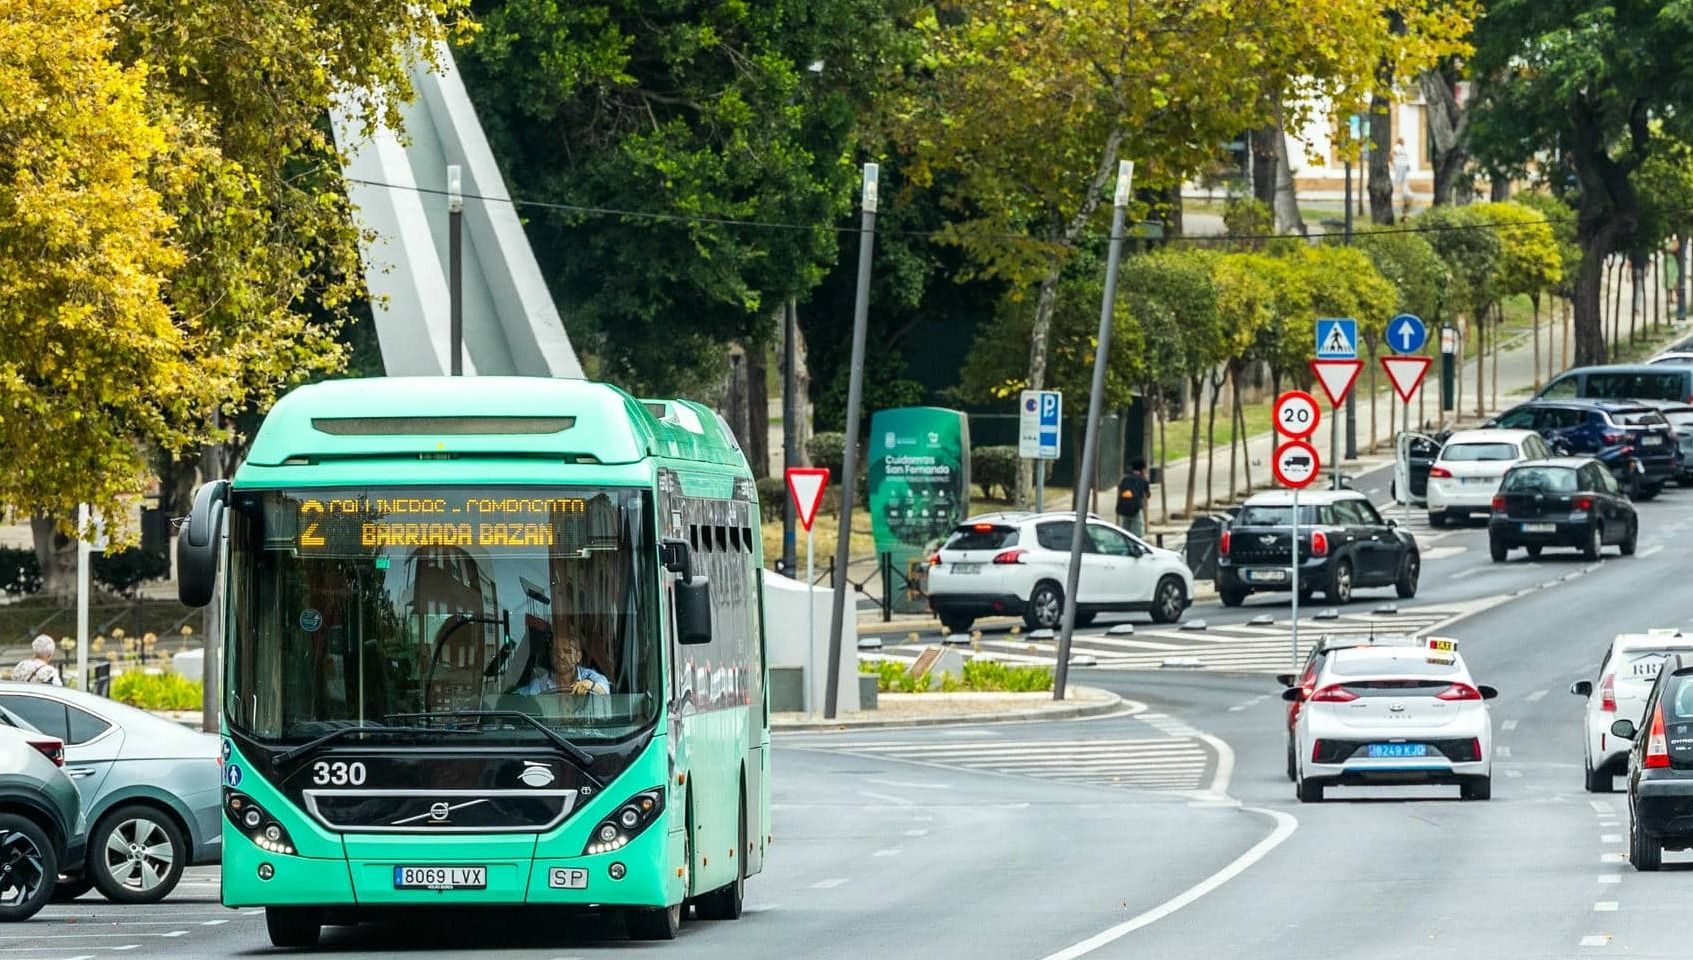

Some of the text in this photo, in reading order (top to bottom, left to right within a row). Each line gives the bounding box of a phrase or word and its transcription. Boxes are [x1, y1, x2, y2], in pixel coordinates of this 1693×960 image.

[1284, 408, 1309, 423] 20
[885, 464, 950, 475] San Fernando
[301, 500, 324, 546] 2
[361, 522, 473, 546] BARRIADA
[312, 762, 367, 785] 330
[405, 869, 481, 884] 8069 LVX
[553, 870, 584, 887] SP
